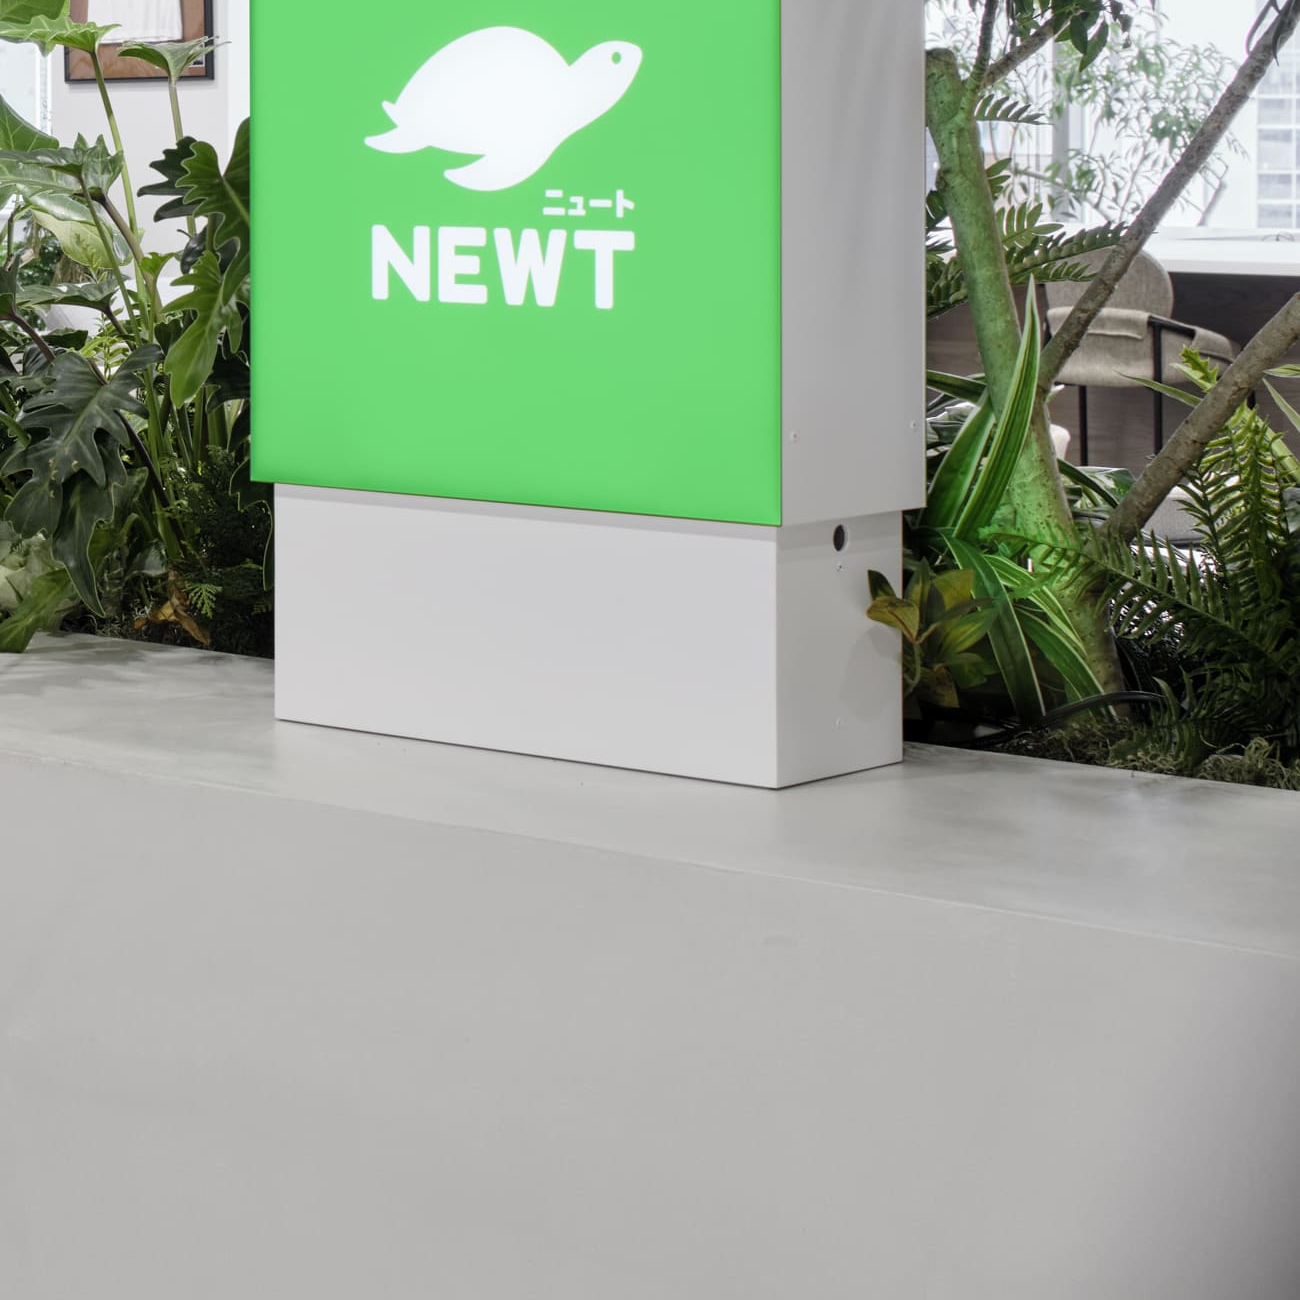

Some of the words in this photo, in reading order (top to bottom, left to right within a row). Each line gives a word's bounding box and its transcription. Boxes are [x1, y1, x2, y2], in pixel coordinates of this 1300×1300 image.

[542, 188, 635, 218] ニュート
[371, 223, 635, 309] NEWT
